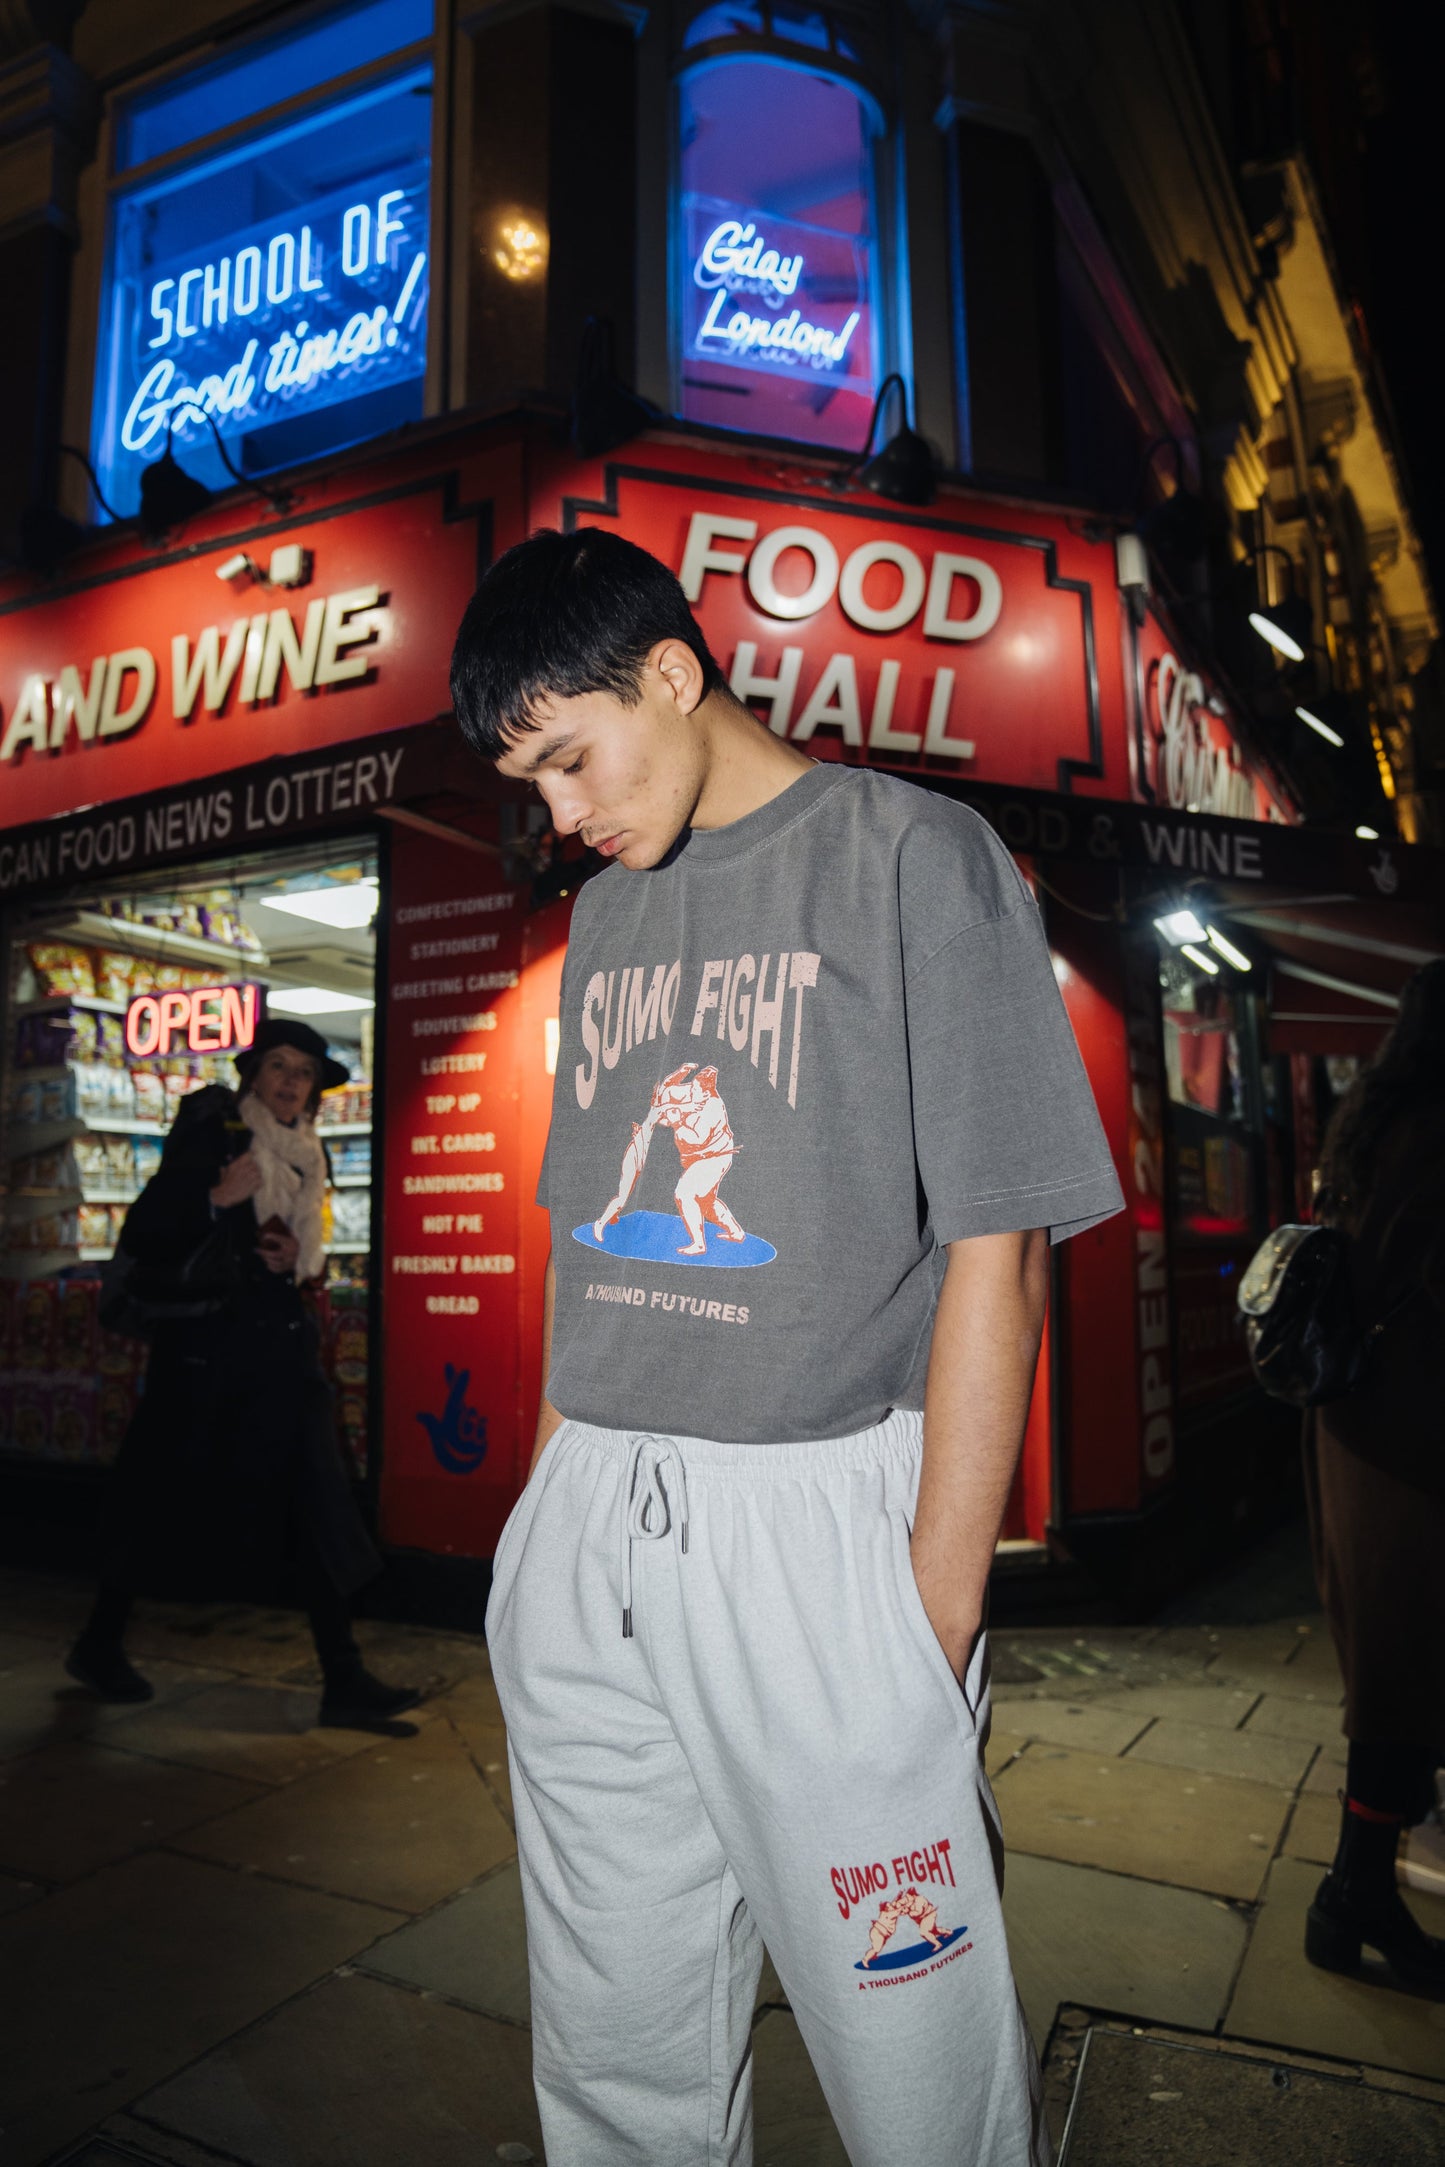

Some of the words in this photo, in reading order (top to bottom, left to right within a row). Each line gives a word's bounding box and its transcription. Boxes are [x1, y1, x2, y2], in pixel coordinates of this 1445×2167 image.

[149, 225, 323, 348] SCHOOL
[342, 189, 405, 276] OF
[121, 338, 259, 451] Good
[264, 252, 426, 392] times!
[679, 511, 1003, 641] FOOD
[0, 646, 156, 760] AND
[171, 584, 380, 719] WINE
[728, 640, 976, 760] HALL
[58, 814, 136, 876] FOOD
[145, 789, 233, 855] NEWS
[246, 749, 404, 831] LOTTERY
[1087, 813, 1122, 860] &
[1142, 819, 1264, 879] WINE
[395, 892, 515, 925] CONFECTIONERY
[410, 932, 500, 960] STATIONERY
[391, 976, 464, 1000] GREETING
[466, 969, 520, 993] CARDS
[126, 984, 257, 1057] OPEN
[412, 1010, 498, 1038] SOUVENIRS
[575, 959, 681, 1110] SUMO
[691, 951, 821, 1111] FIGHT
[421, 1051, 487, 1076] LOTTERY
[426, 1094, 456, 1114] TOP
[458, 1092, 482, 1113] UP
[442, 1131, 496, 1154] CARDS
[403, 1171, 505, 1195] SANDWICHES
[422, 1214, 454, 1234] HOT
[456, 1213, 484, 1233] PIE
[392, 1255, 459, 1275] FRESHLY
[460, 1254, 516, 1274] BAKED
[425, 1296, 480, 1315] BREAD
[650, 1290, 750, 1325] FUTURES
[830, 1863, 888, 1920] SUMO
[891, 1838, 956, 1888] FIGHT
[858, 1982, 866, 1990] A
[868, 1968, 928, 1989] THOUSAND
[930, 1942, 973, 1973] FUTURES
